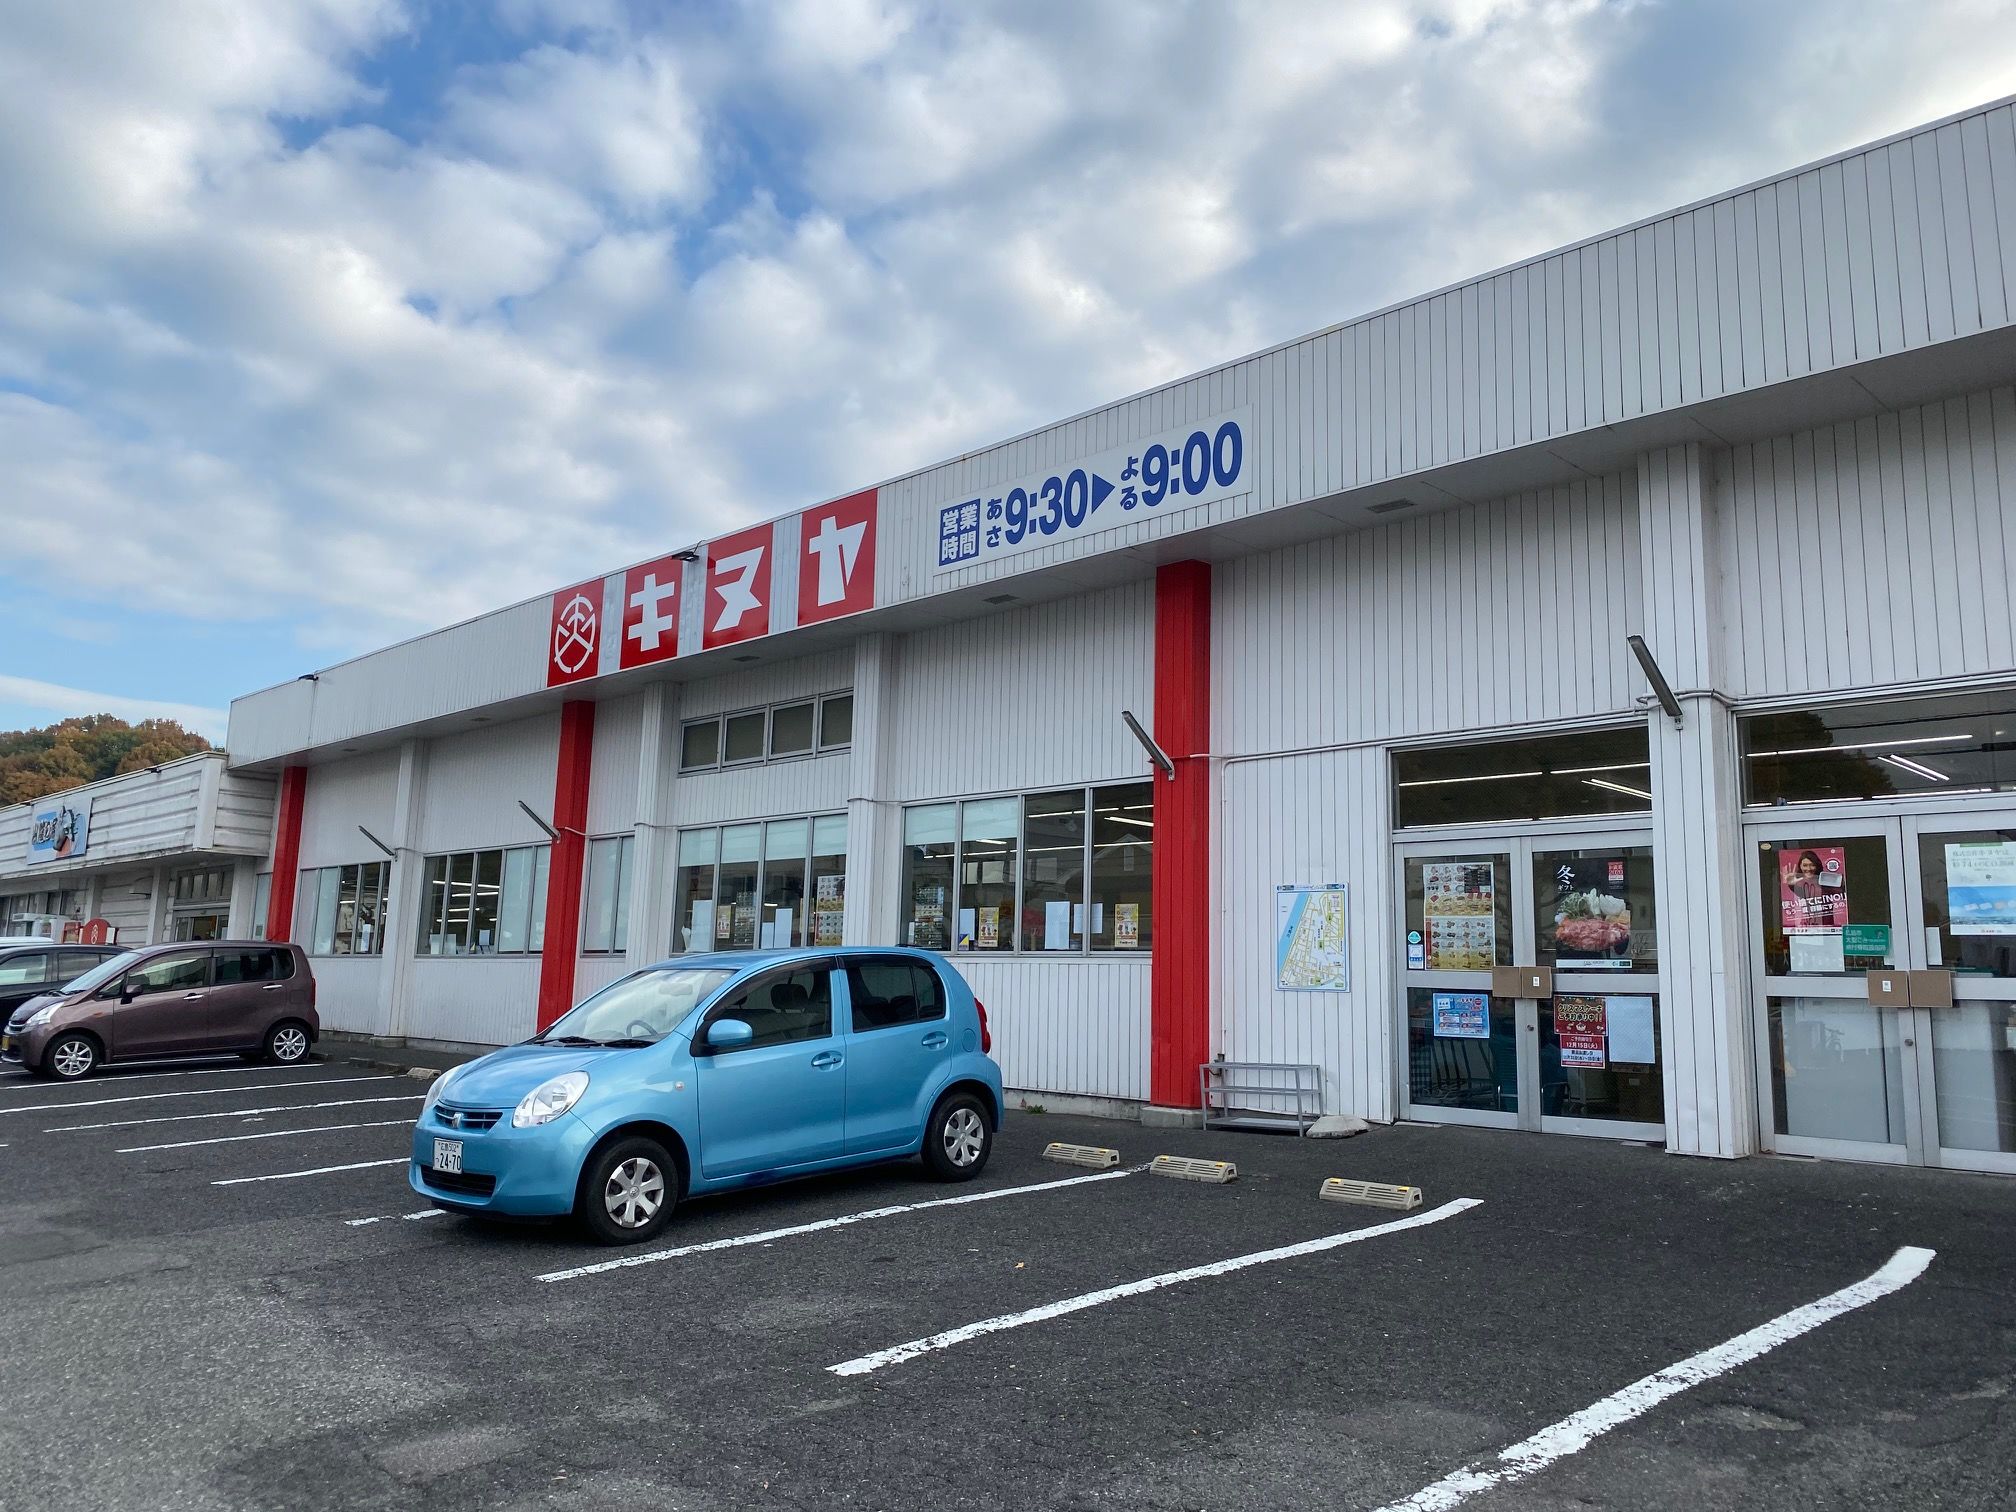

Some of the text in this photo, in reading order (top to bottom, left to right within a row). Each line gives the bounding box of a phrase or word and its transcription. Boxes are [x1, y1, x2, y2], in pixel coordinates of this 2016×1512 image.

[1120, 421, 1243, 511] よる 9:00
[941, 504, 978, 537] 営業
[986, 469, 1088, 548] あさ 9:30
[940, 532, 977, 561] 時間
[1557, 864, 1575, 885] 冬
